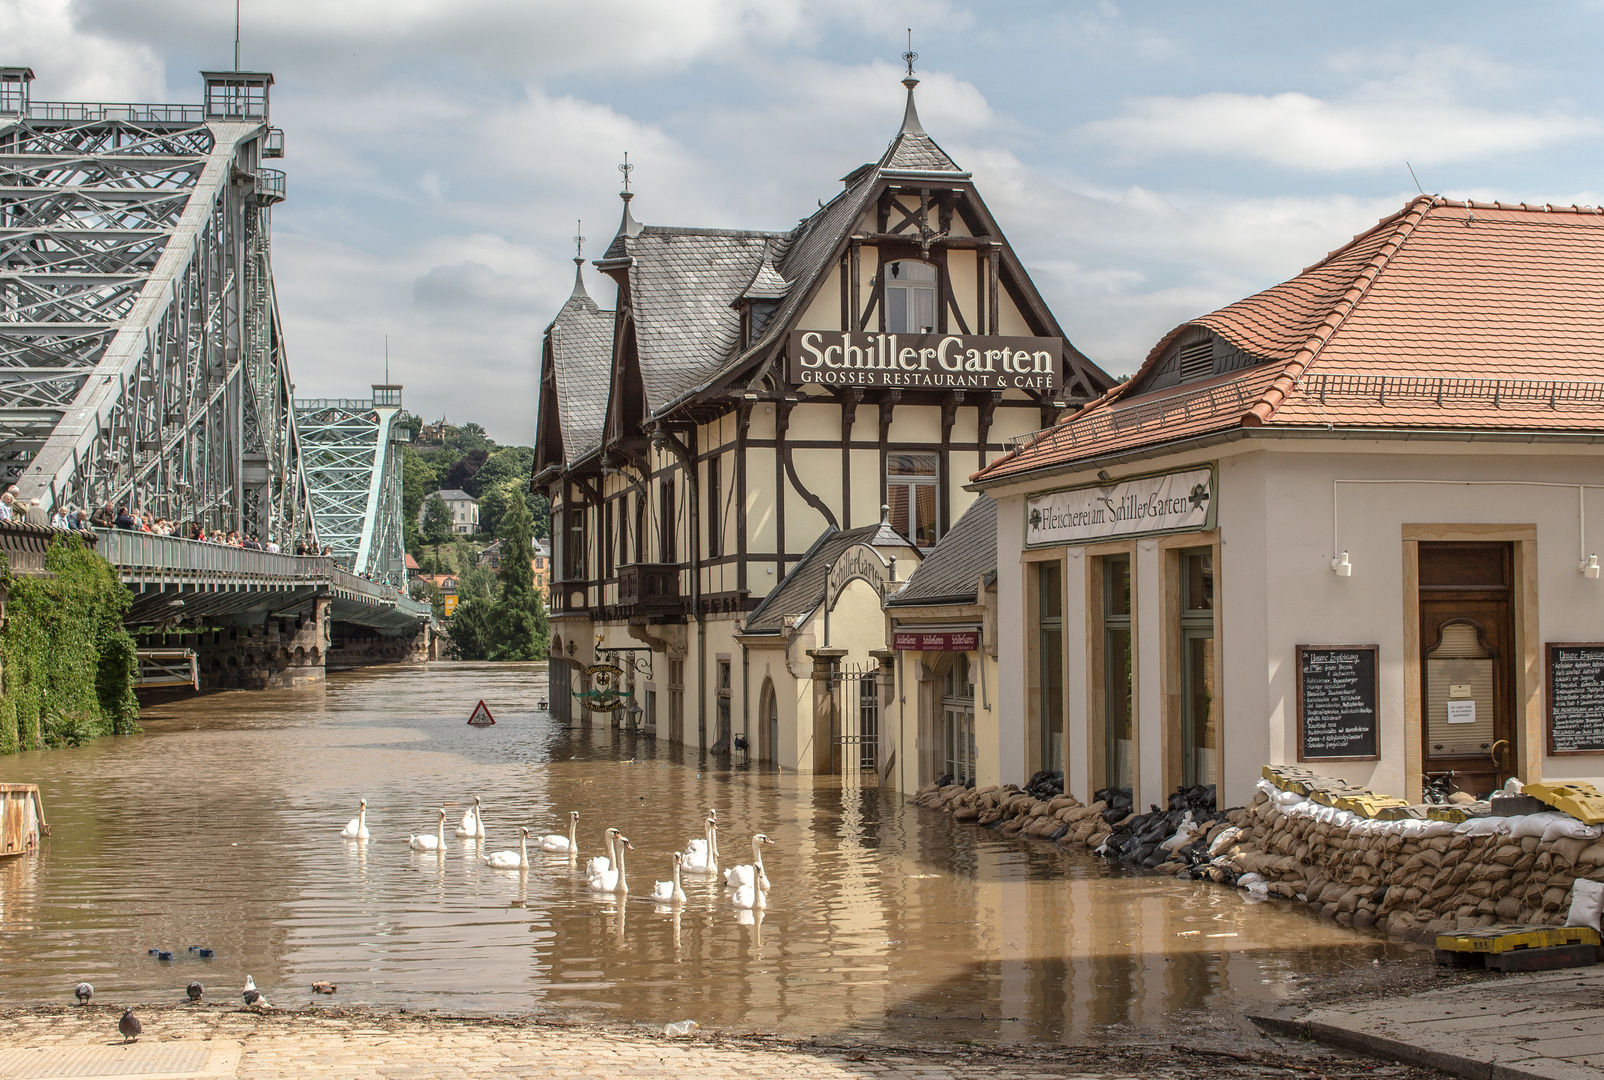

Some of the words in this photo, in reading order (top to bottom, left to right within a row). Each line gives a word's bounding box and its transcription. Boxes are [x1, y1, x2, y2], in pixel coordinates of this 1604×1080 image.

[800, 332, 1055, 375] SchillerGarten
[801, 371, 875, 384] GROSSES
[883, 373, 990, 387] RESTAURANT
[996, 375, 1007, 387] &
[1014, 374, 1054, 389] CAFÉ
[1041, 503, 1091, 531] Fleischerei
[1092, 509, 1106, 525] am
[1105, 492, 1187, 523] SchillerGarten
[1310, 653, 1328, 663] Unsere
